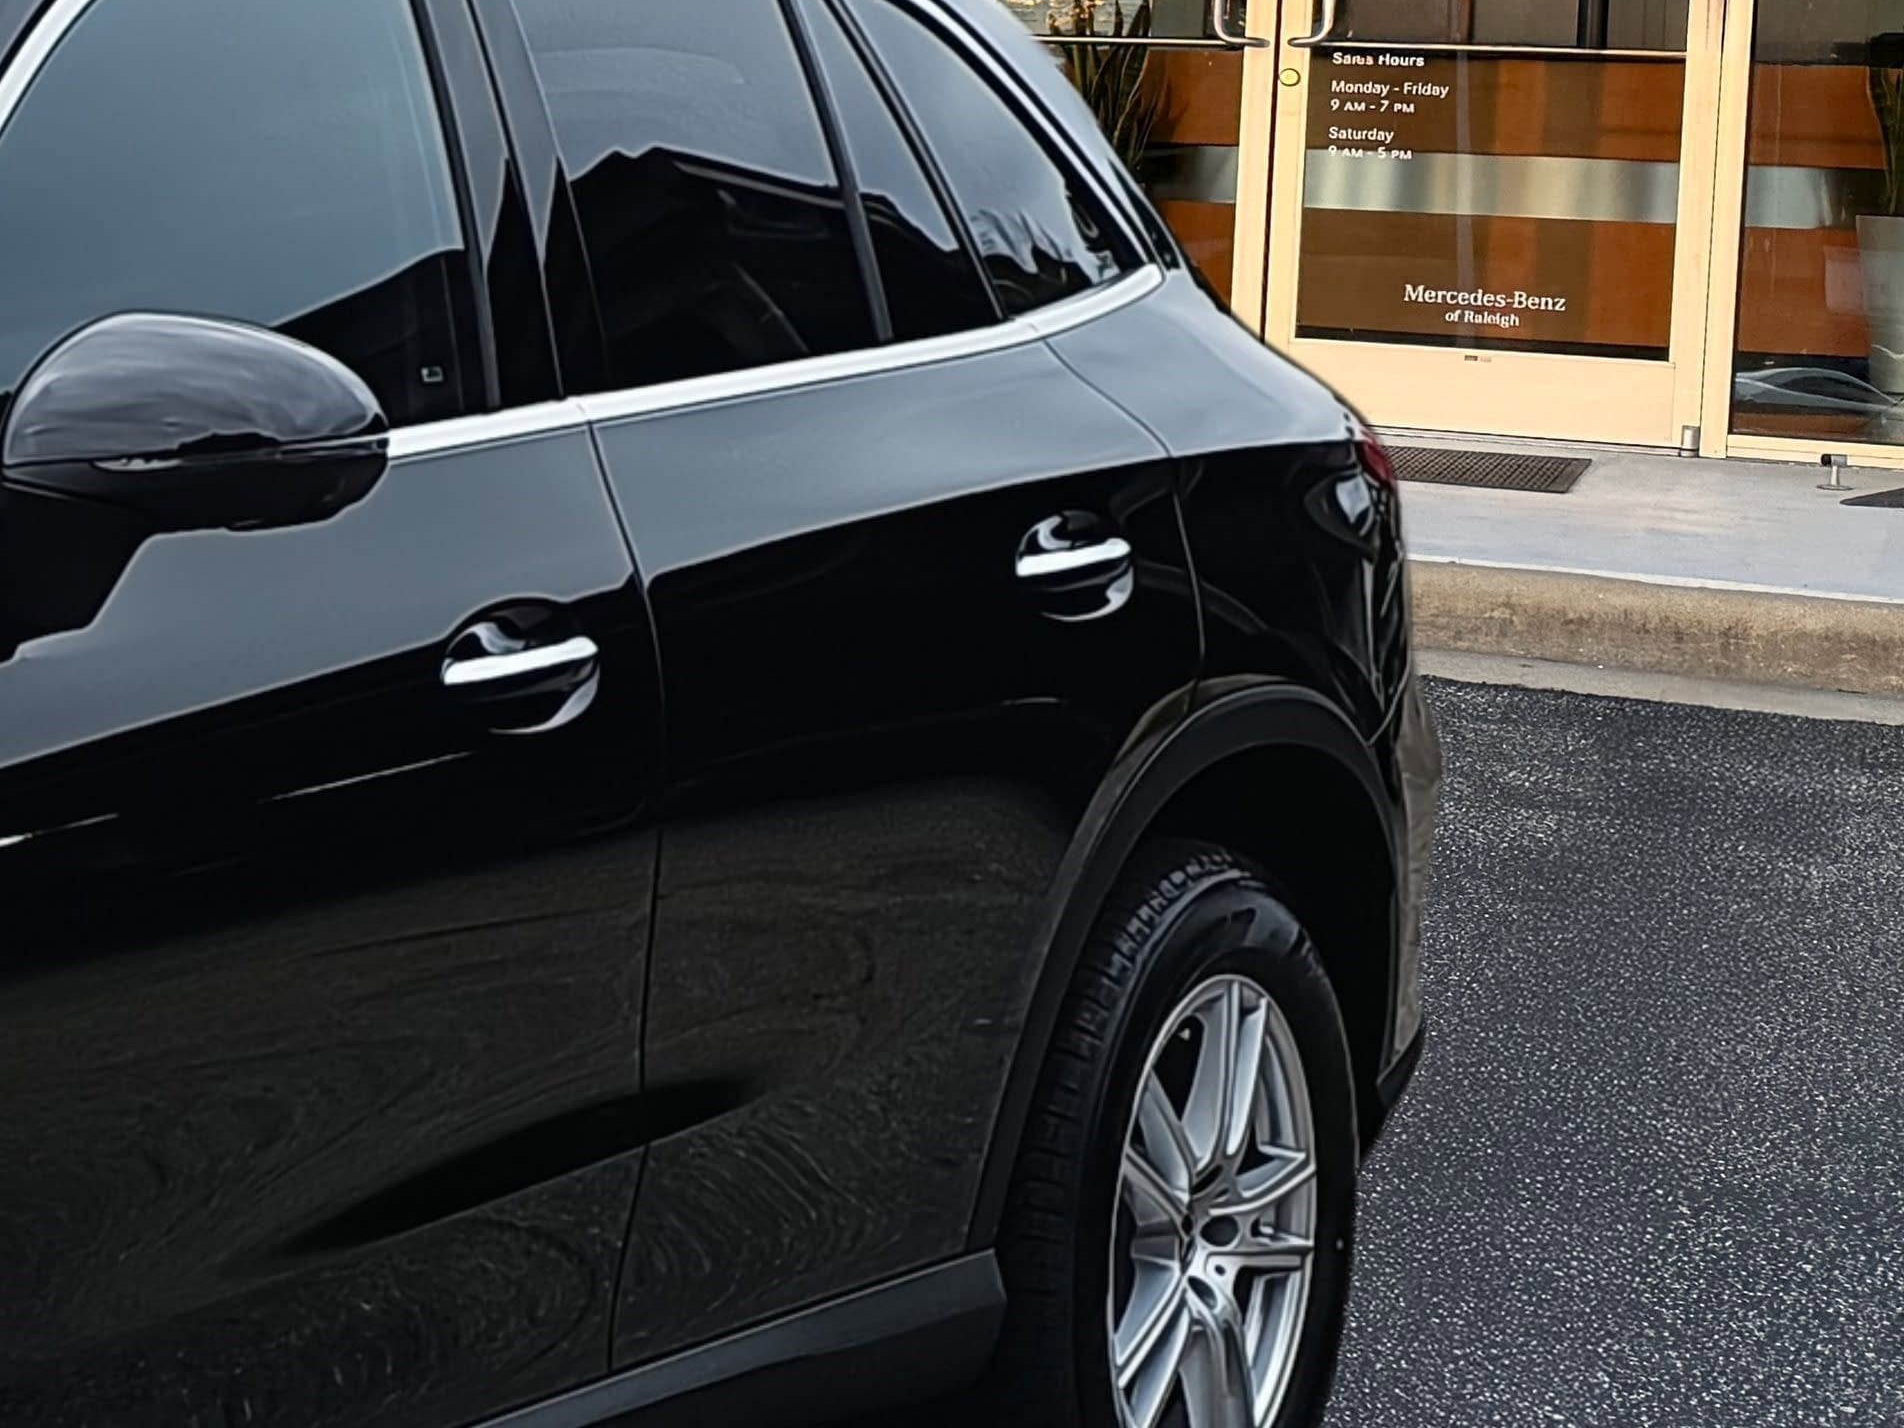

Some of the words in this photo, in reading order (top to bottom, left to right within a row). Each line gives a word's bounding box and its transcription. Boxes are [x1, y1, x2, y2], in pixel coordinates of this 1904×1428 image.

[1378, 53, 1425, 67] Hours
[1331, 79, 1390, 97] Monday
[1403, 81, 1449, 98] Friday
[1330, 98, 1340, 111] 9
[1344, 101, 1365, 111] AM
[1380, 100, 1389, 112] 7
[1393, 103, 1414, 113] PM
[1328, 126, 1394, 144] Saturday
[1328, 145, 1337, 157] 9
[1342, 148, 1363, 158] AM
[1377, 147, 1386, 159] 5
[1391, 150, 1412, 160] PM
[1403, 284, 1566, 312] Mercedes-Benz
[1445, 309, 1461, 322] of
[1464, 310, 1520, 329] Raleigh
